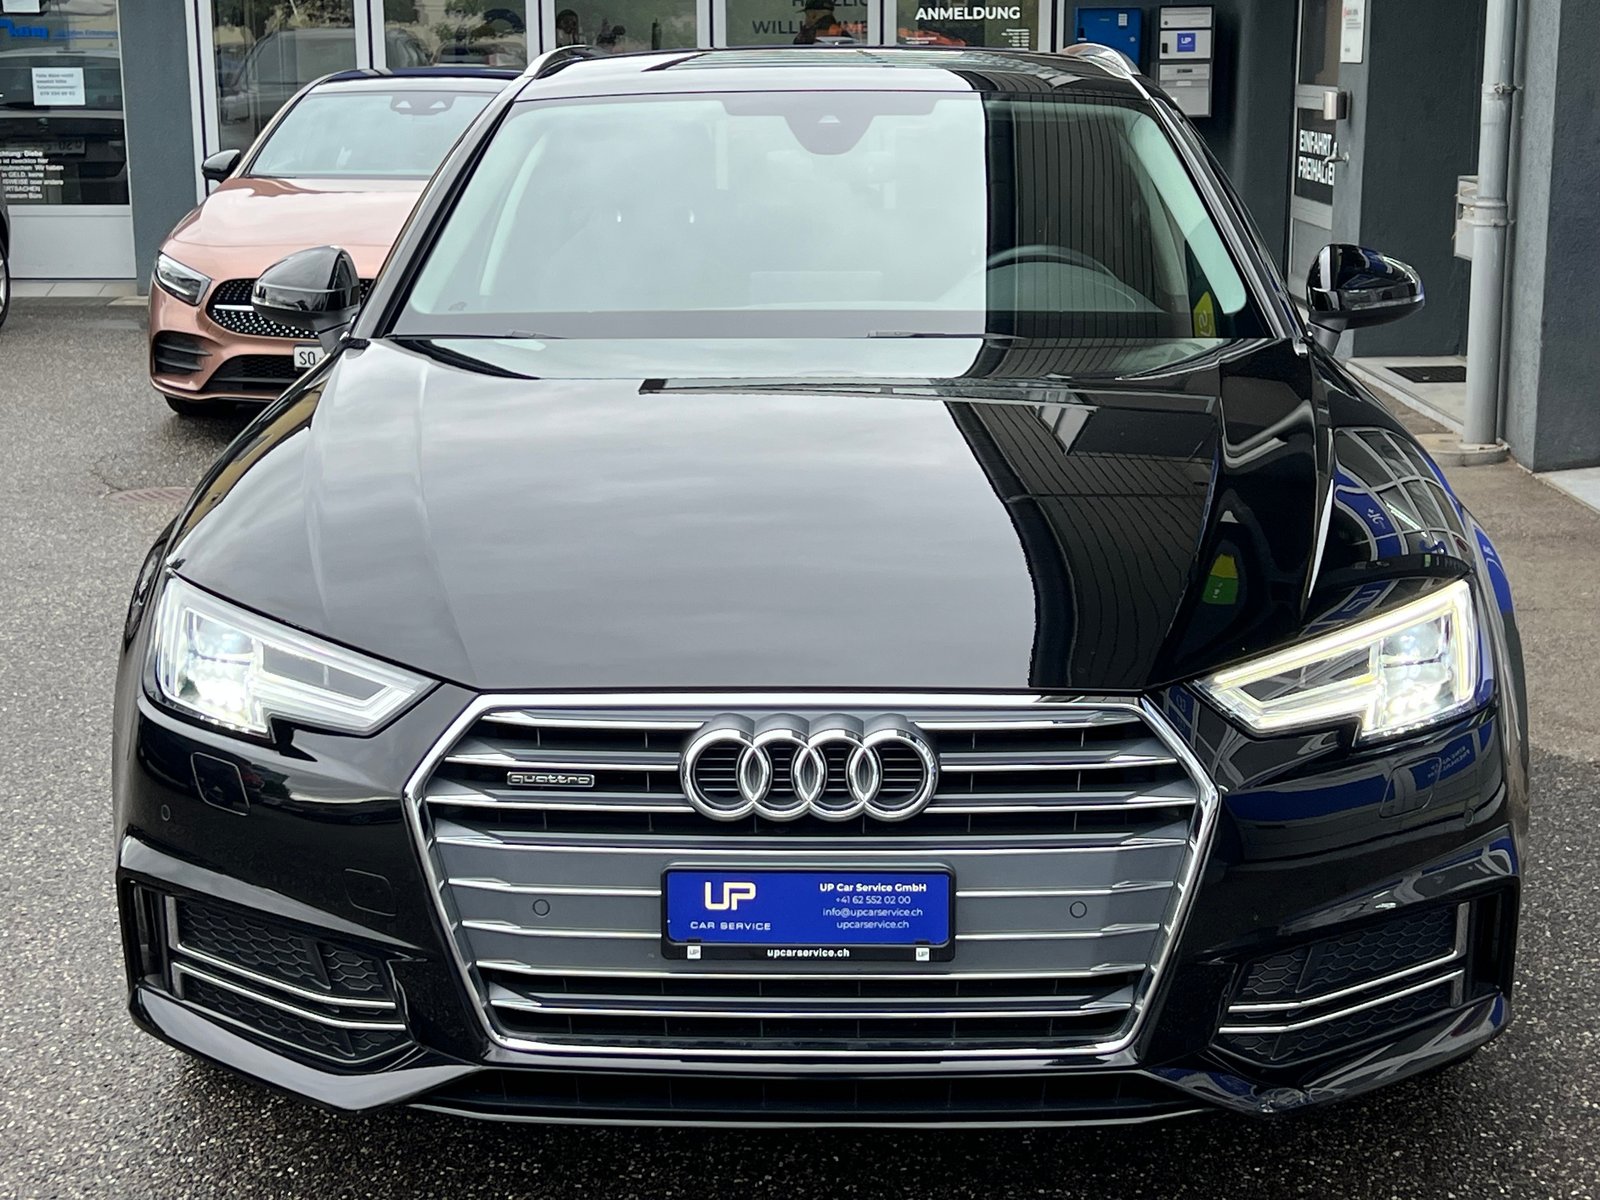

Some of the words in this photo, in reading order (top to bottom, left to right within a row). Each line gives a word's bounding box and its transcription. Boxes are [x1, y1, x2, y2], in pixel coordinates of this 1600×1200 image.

[915, 6, 1021, 20] ANMELDUNG
[1299, 129, 1332, 156] EINFAHRT
[299, 351, 316, 366] SO
[511, 774, 590, 785] quattro
[819, 883, 835, 892] UP
[836, 883, 855, 892] Car
[856, 883, 892, 892] Service
[894, 883, 927, 892] GmbH
[704, 881, 757, 911] UP
[835, 896, 851, 905] +41
[852, 895, 864, 905] 62
[866, 895, 882, 905] 552
[884, 895, 896, 905] 02
[897, 895, 911, 905] 00
[823, 907, 923, 918] info@upcarservice.ch
[690, 921, 716, 930] CAR
[720, 922, 772, 931] SERVICE
[836, 920, 910, 930] upcarservice.ch
[767, 947, 850, 959] upcarservice.ch
[917, 950, 929, 958] UP
